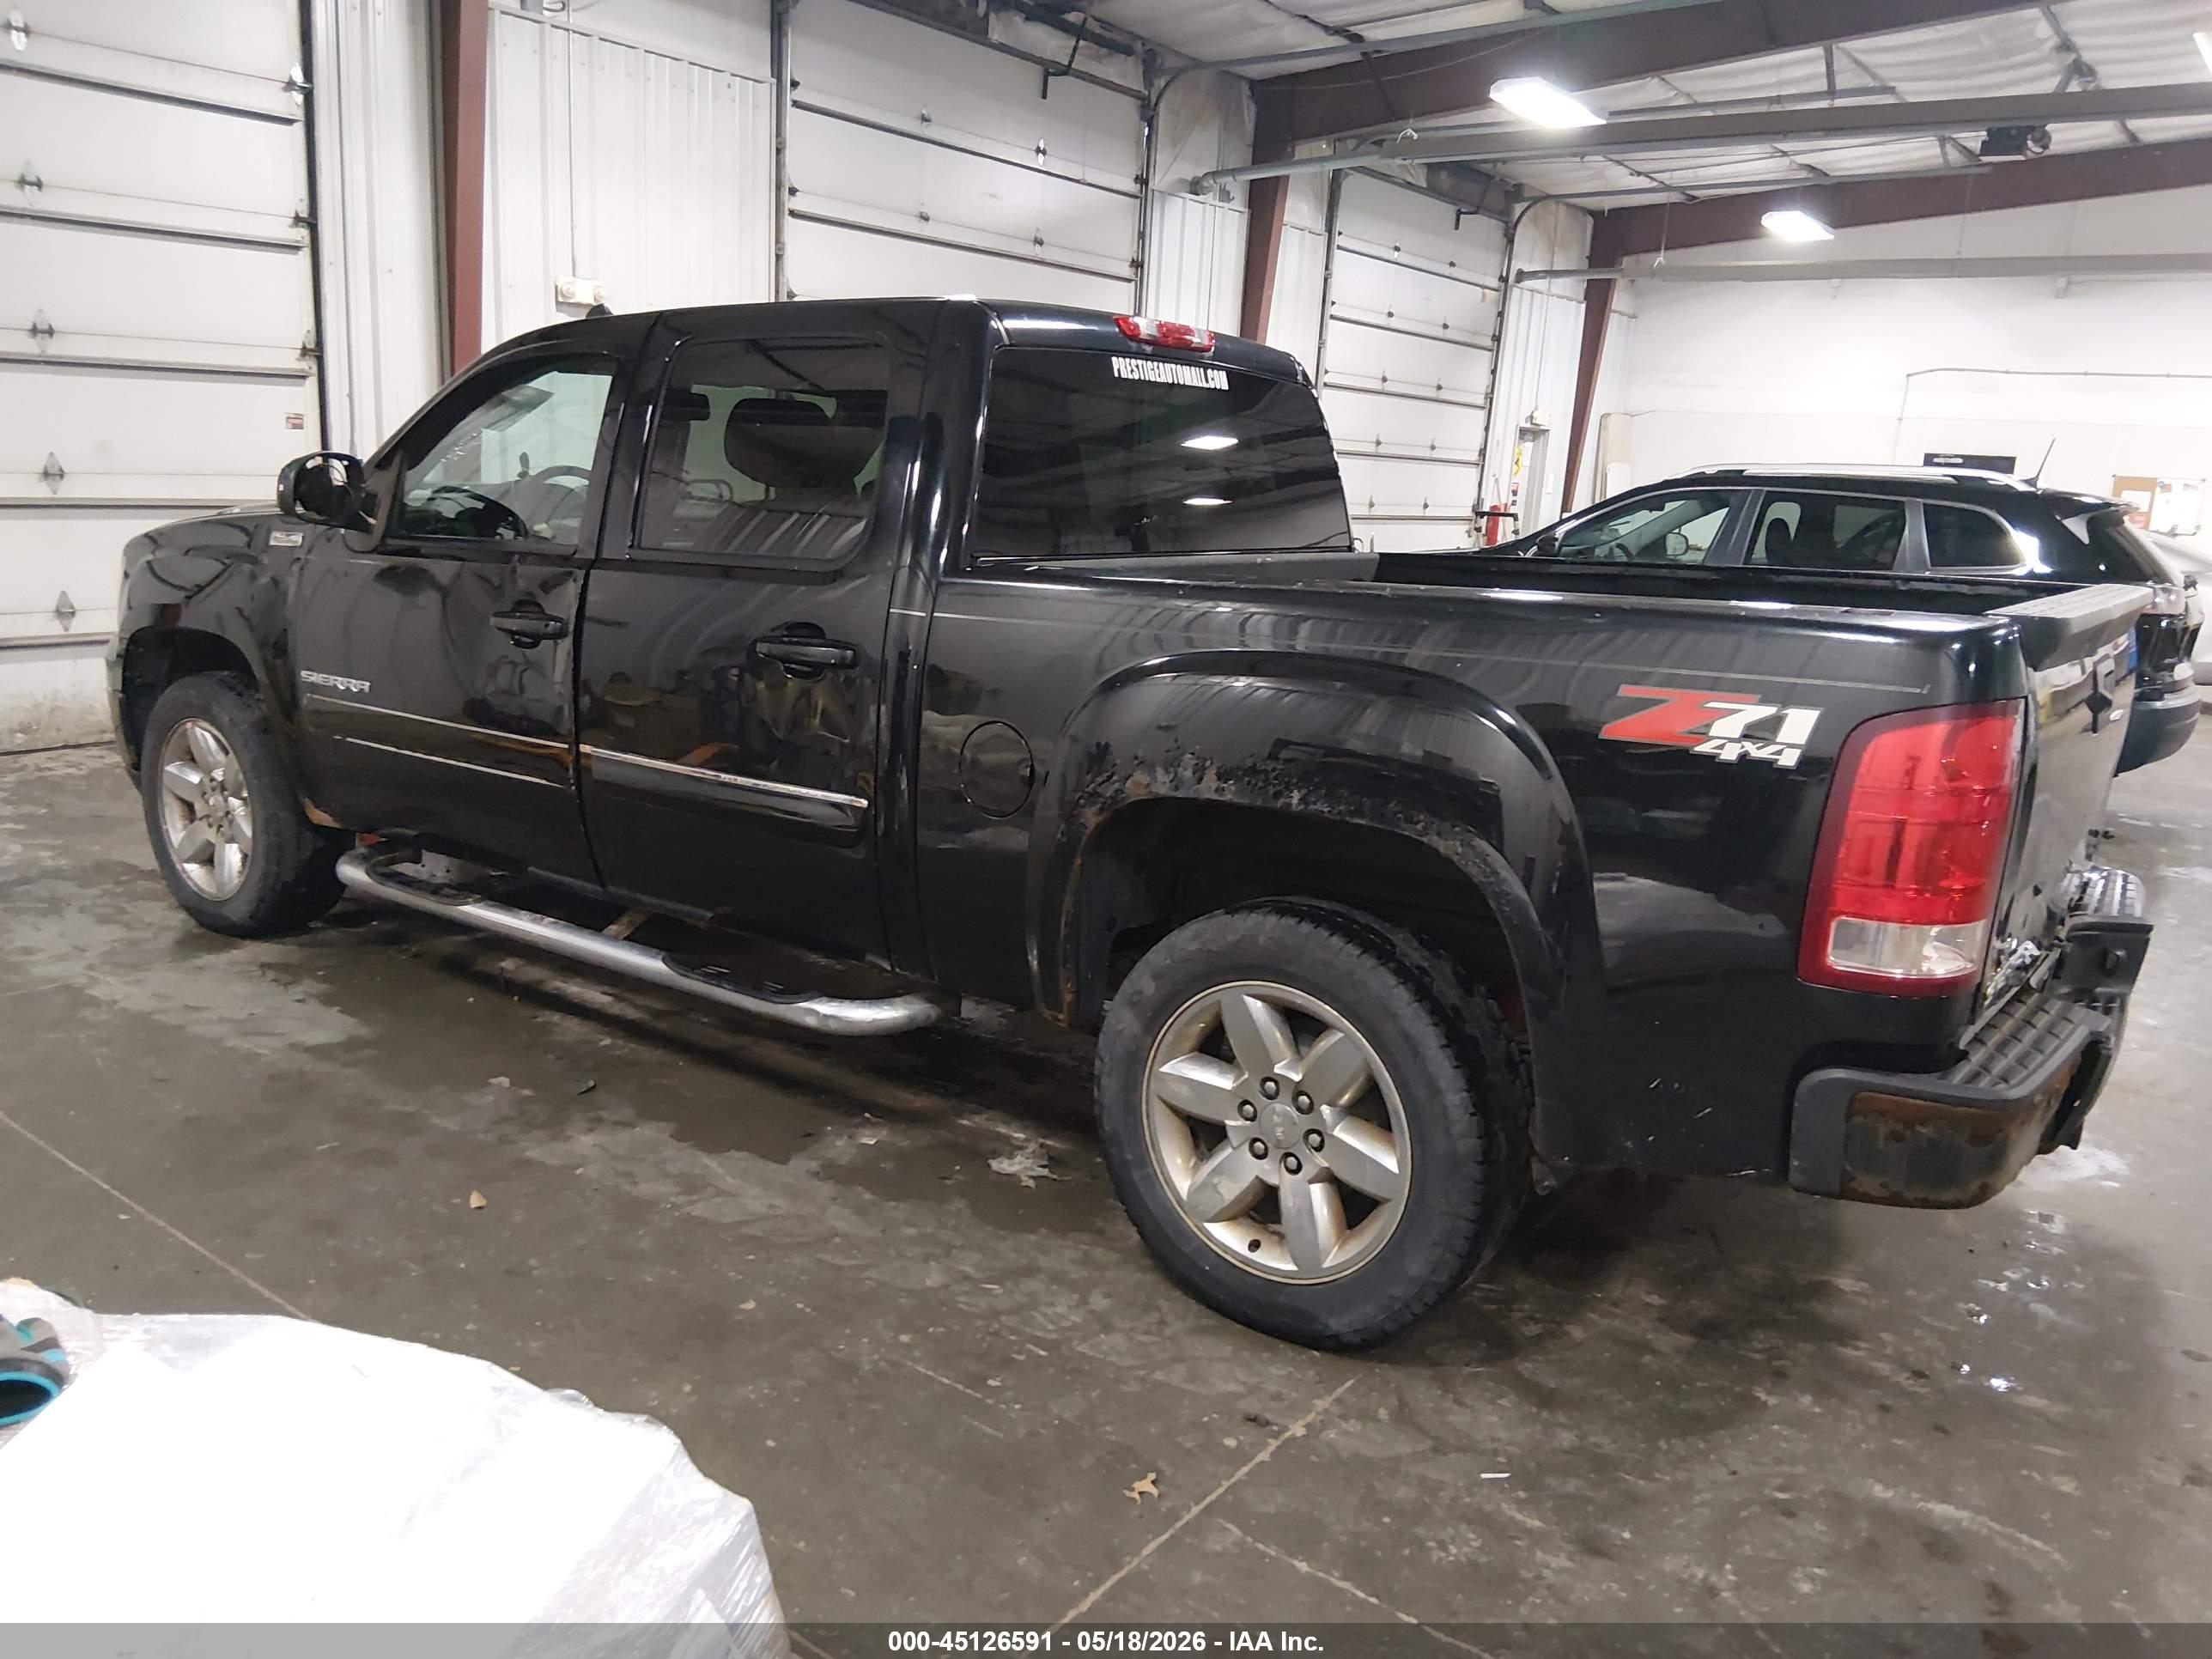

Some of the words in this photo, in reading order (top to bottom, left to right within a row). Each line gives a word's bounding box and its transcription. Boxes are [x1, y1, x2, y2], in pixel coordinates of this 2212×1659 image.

[1111, 356, 1230, 391] PRESTIGEAUTOMALL.COM
[300, 670, 372, 694] SIERRA
[1597, 684, 1824, 748] Z71
